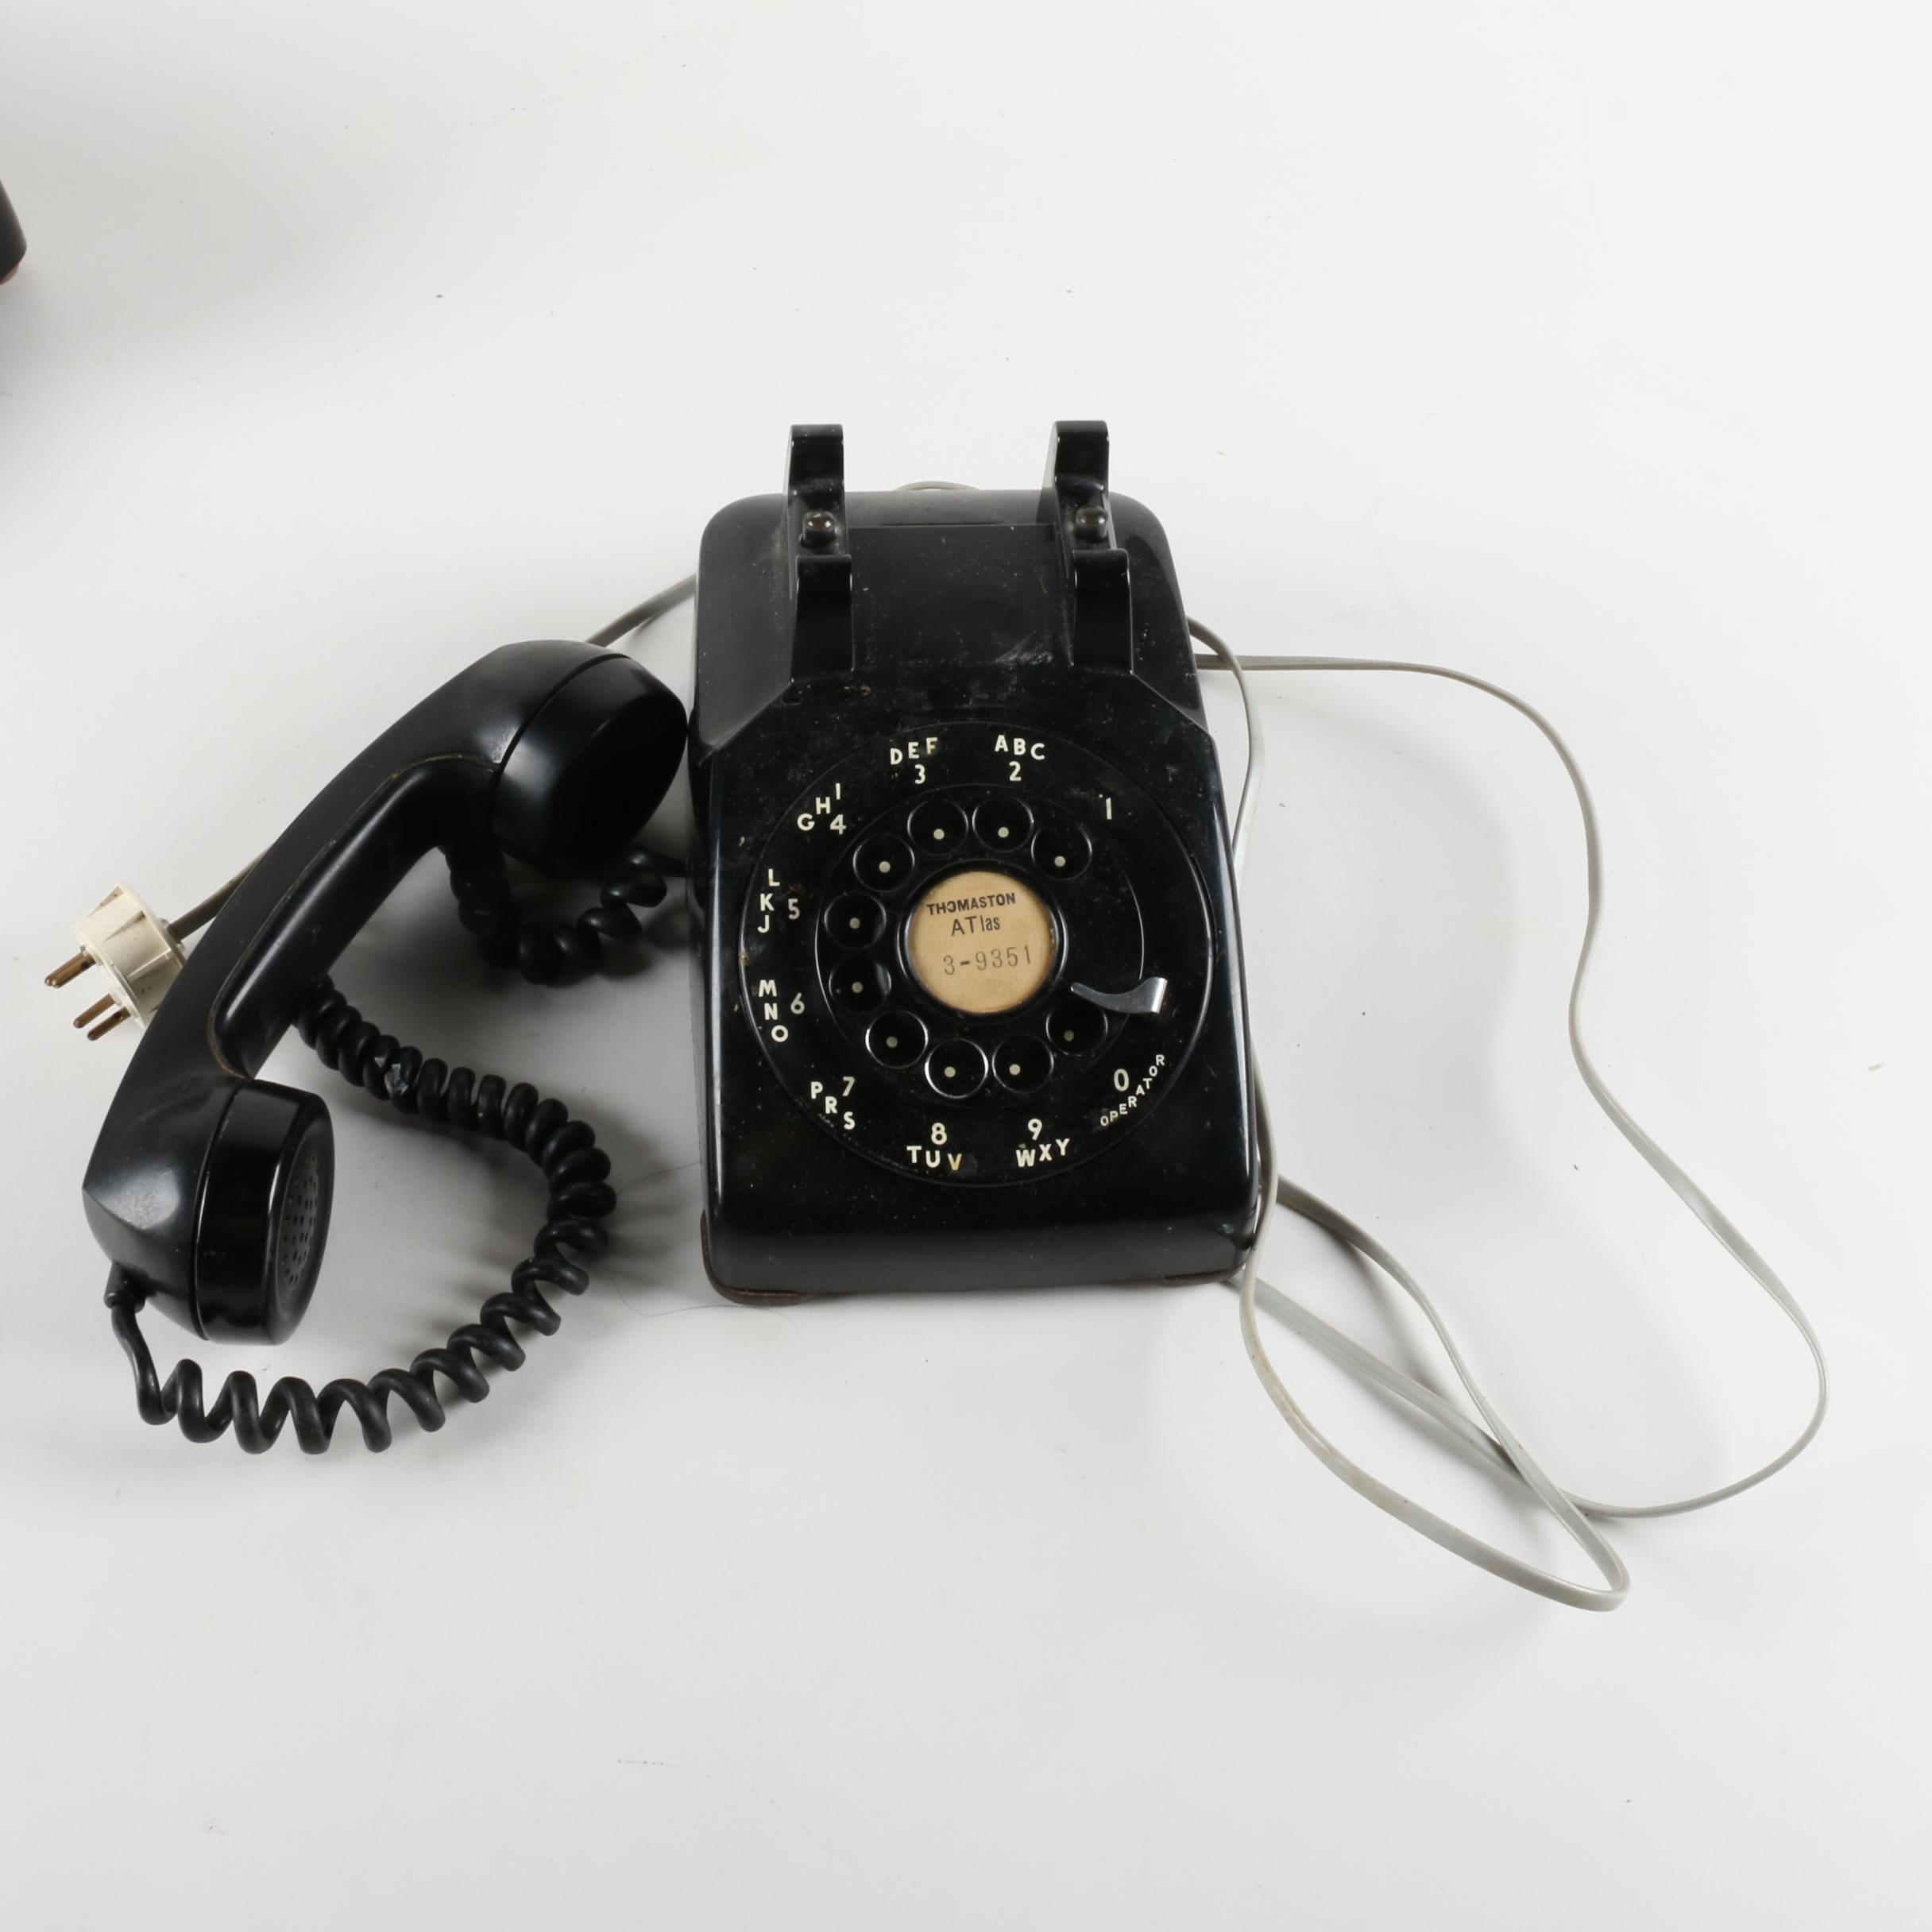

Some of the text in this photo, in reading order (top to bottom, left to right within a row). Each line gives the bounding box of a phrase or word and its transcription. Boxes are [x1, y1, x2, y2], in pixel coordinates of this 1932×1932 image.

[994, 734, 1045, 761] ABC
[914, 764, 926, 785] 3
[1009, 760, 1022, 782] 2
[829, 813, 847, 835] 4
[788, 898, 800, 920] 5
[926, 892, 1016, 915] THOMASTON
[942, 945, 1032, 976] 3-9351
[790, 992, 805, 1014] 6
[842, 1076, 856, 1097] 7
[1099, 1053, 1165, 1126] OPERATOR
[1113, 1068, 1130, 1092] 0
[930, 1122, 948, 1146] 8
[1027, 1118, 1043, 1141] 9
